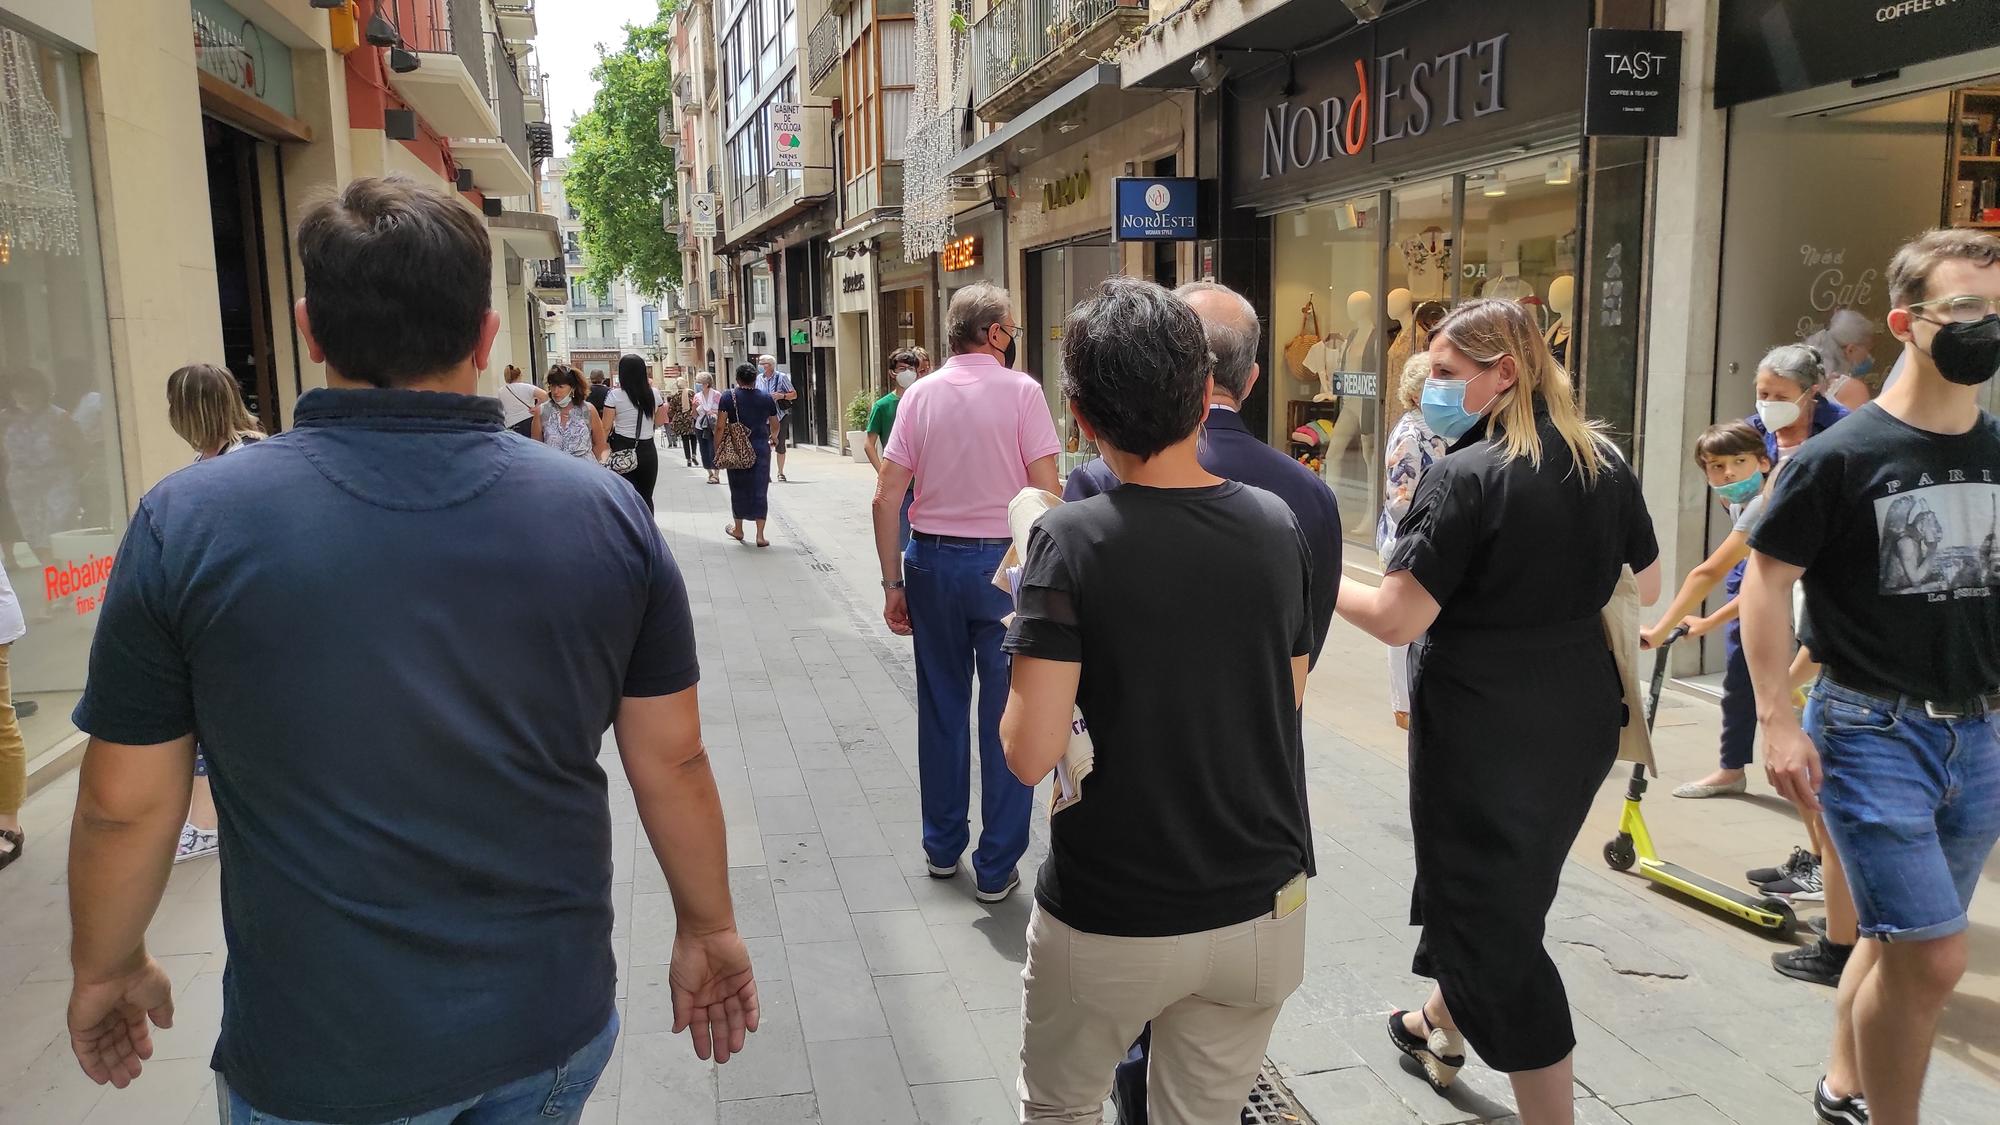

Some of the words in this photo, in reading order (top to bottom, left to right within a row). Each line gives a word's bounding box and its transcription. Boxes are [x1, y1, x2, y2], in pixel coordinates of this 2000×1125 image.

[1604, 51, 1667, 80] TAST
[775, 105, 799, 114] GABINET
[784, 114, 791, 122] DE
[774, 123, 801, 131] PSICOLOGIA
[1343, 374, 1376, 395] REBAIXES
